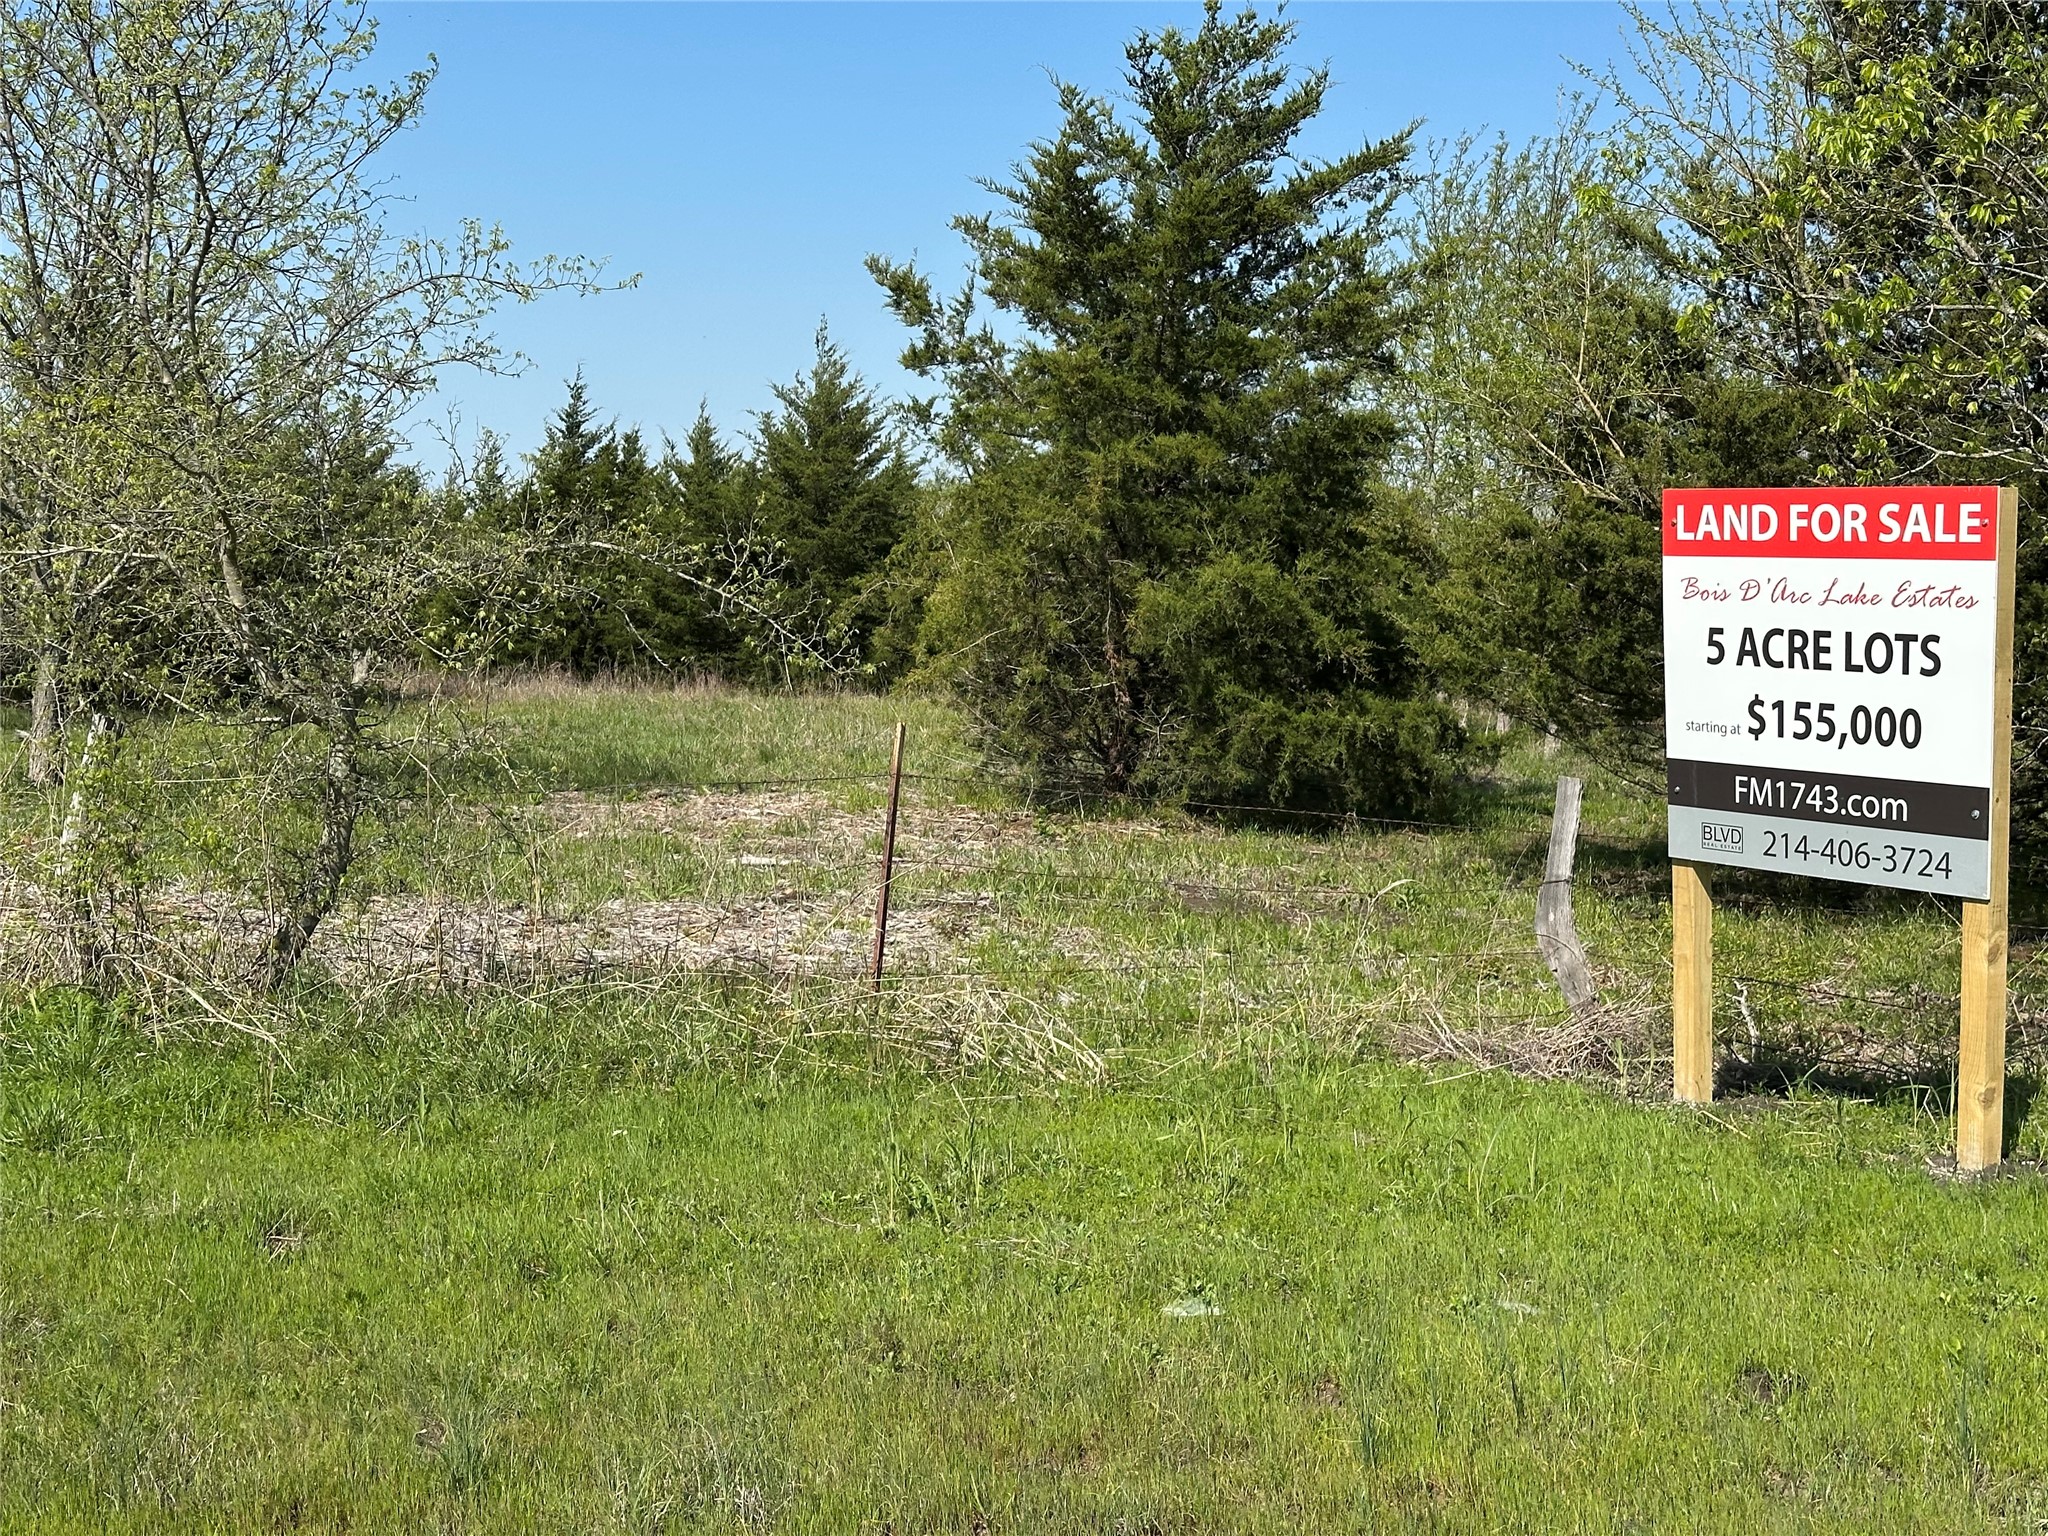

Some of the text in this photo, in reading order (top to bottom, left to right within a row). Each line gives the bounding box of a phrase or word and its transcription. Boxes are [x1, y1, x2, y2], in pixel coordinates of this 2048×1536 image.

[1676, 503, 1982, 544] LAND FOR SALE
[1680, 576, 1979, 609] Bois D'Arc Lake Estates
[1706, 627, 1941, 677] 5 ACRE LOTS
[1685, 694, 1922, 750] starting at $155,000
[1734, 775, 1908, 822] FM1743.com
[1703, 825, 1742, 844] BLVD
[1763, 830, 1953, 880] 214-406-3724
